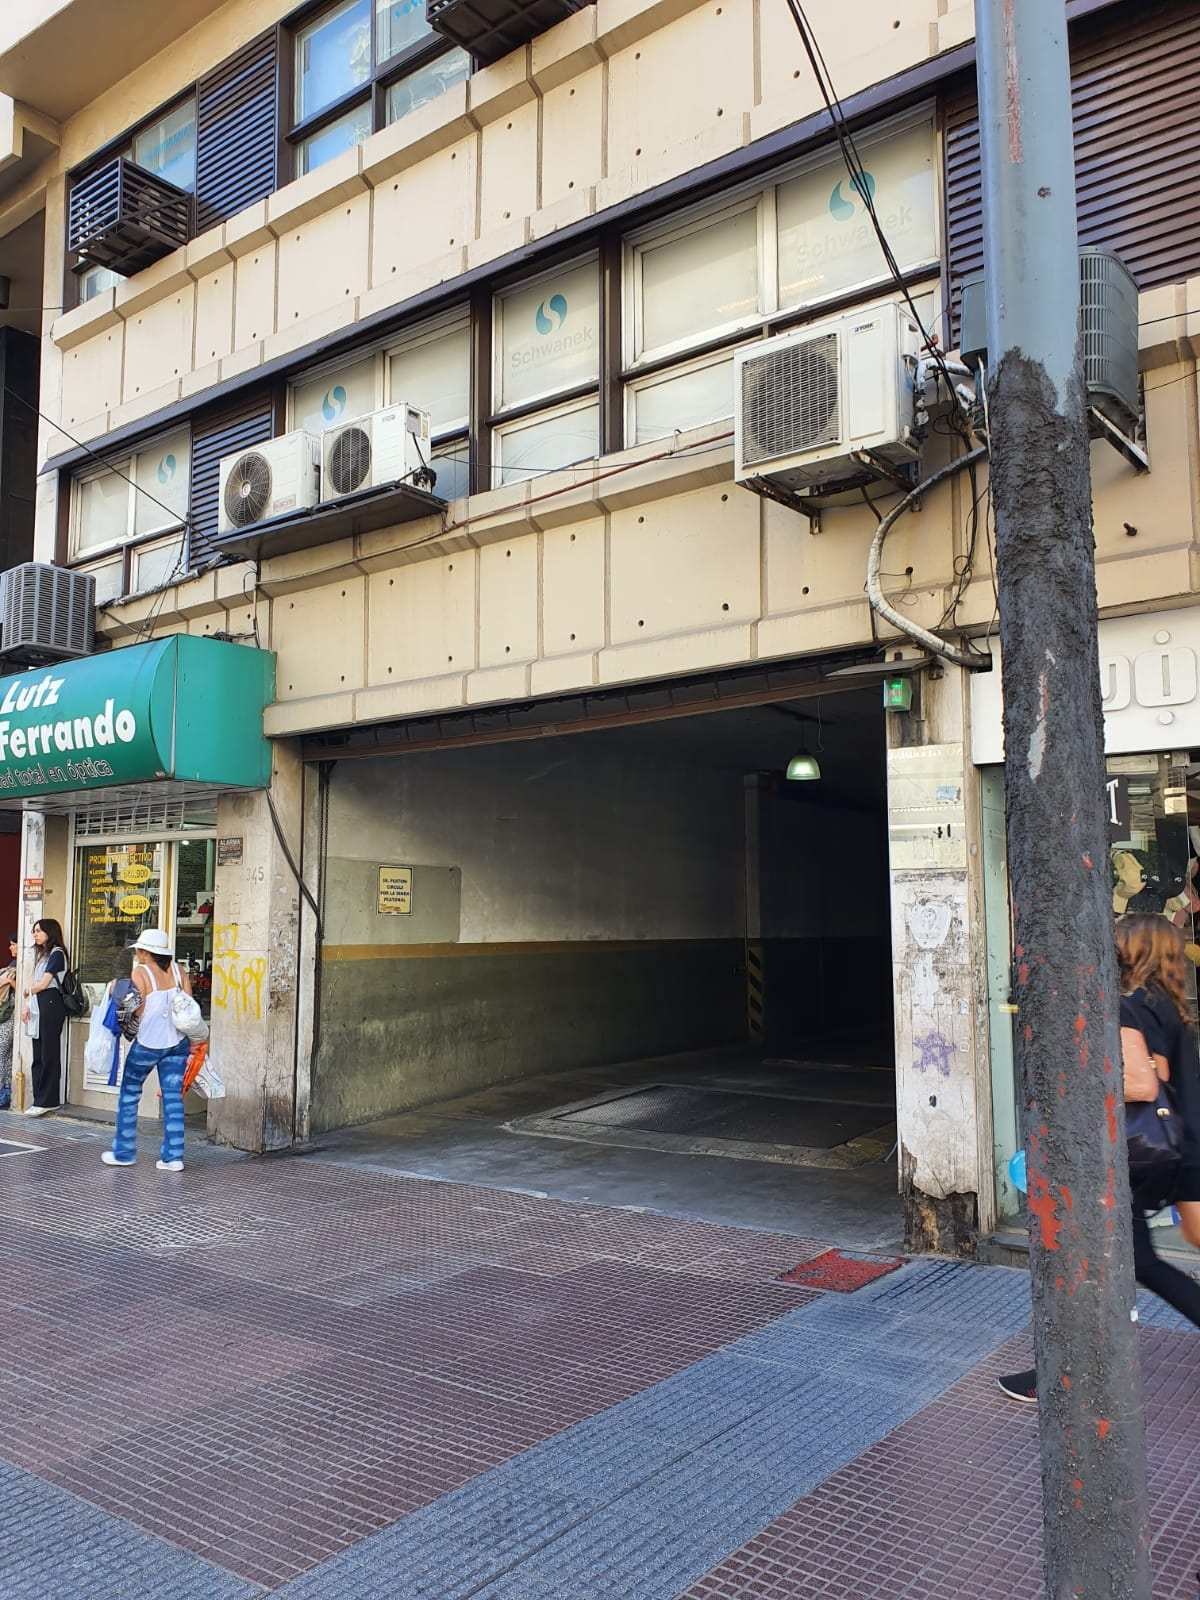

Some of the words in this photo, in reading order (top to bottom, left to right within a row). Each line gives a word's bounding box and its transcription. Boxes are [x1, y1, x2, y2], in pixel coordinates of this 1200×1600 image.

[797, 204, 912, 263] Schwaek
[511, 326, 593, 369] Schwanek
[0, 675, 66, 715] Lutz
[0, 698, 136, 761] Ferrando
[16, 762, 48, 787] total
[49, 767, 67, 782] en
[67, 757, 114, 784] óptica
